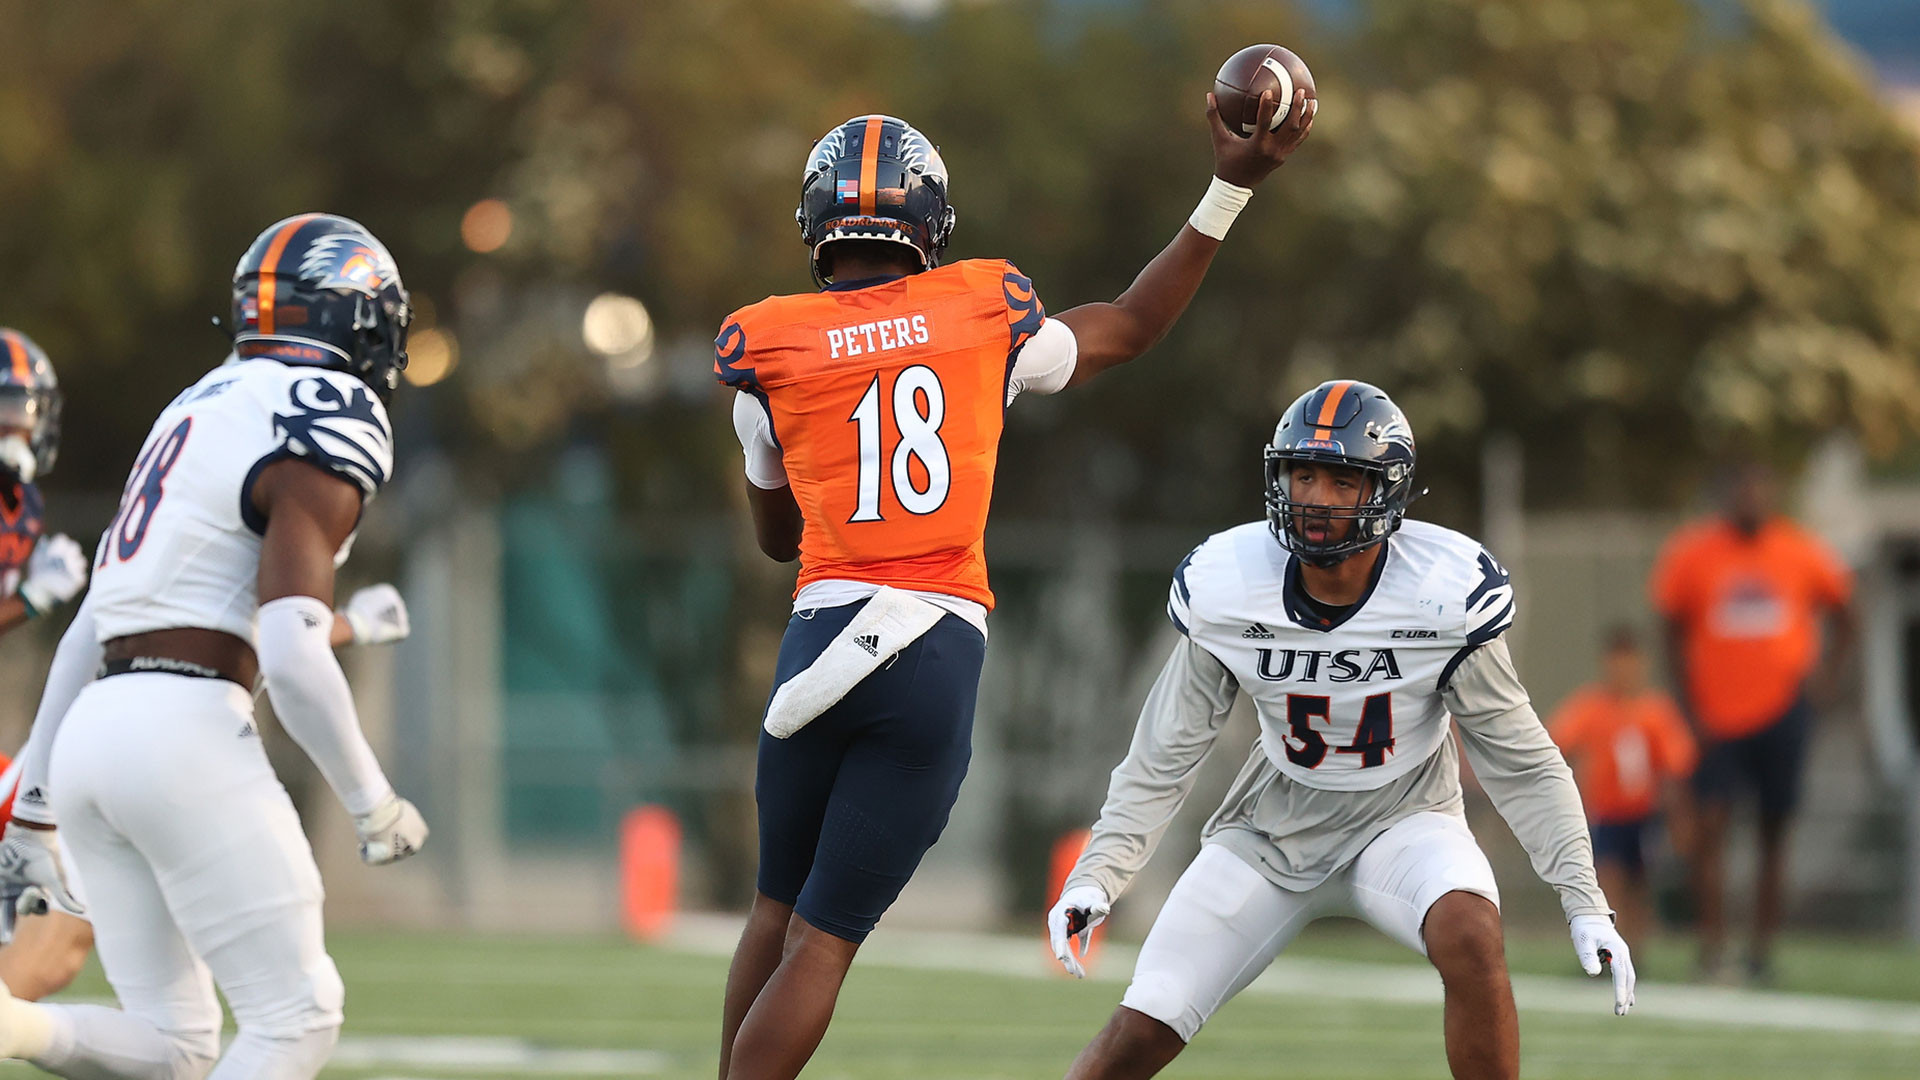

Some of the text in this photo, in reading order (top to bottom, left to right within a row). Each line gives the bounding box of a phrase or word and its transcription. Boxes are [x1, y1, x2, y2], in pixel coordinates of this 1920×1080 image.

[827, 314, 930, 359] PETERS
[846, 364, 951, 524] 18
[853, 636, 879, 658] adidas
[1254, 648, 1403, 683] UTSA
[1281, 691, 1395, 769] 54
